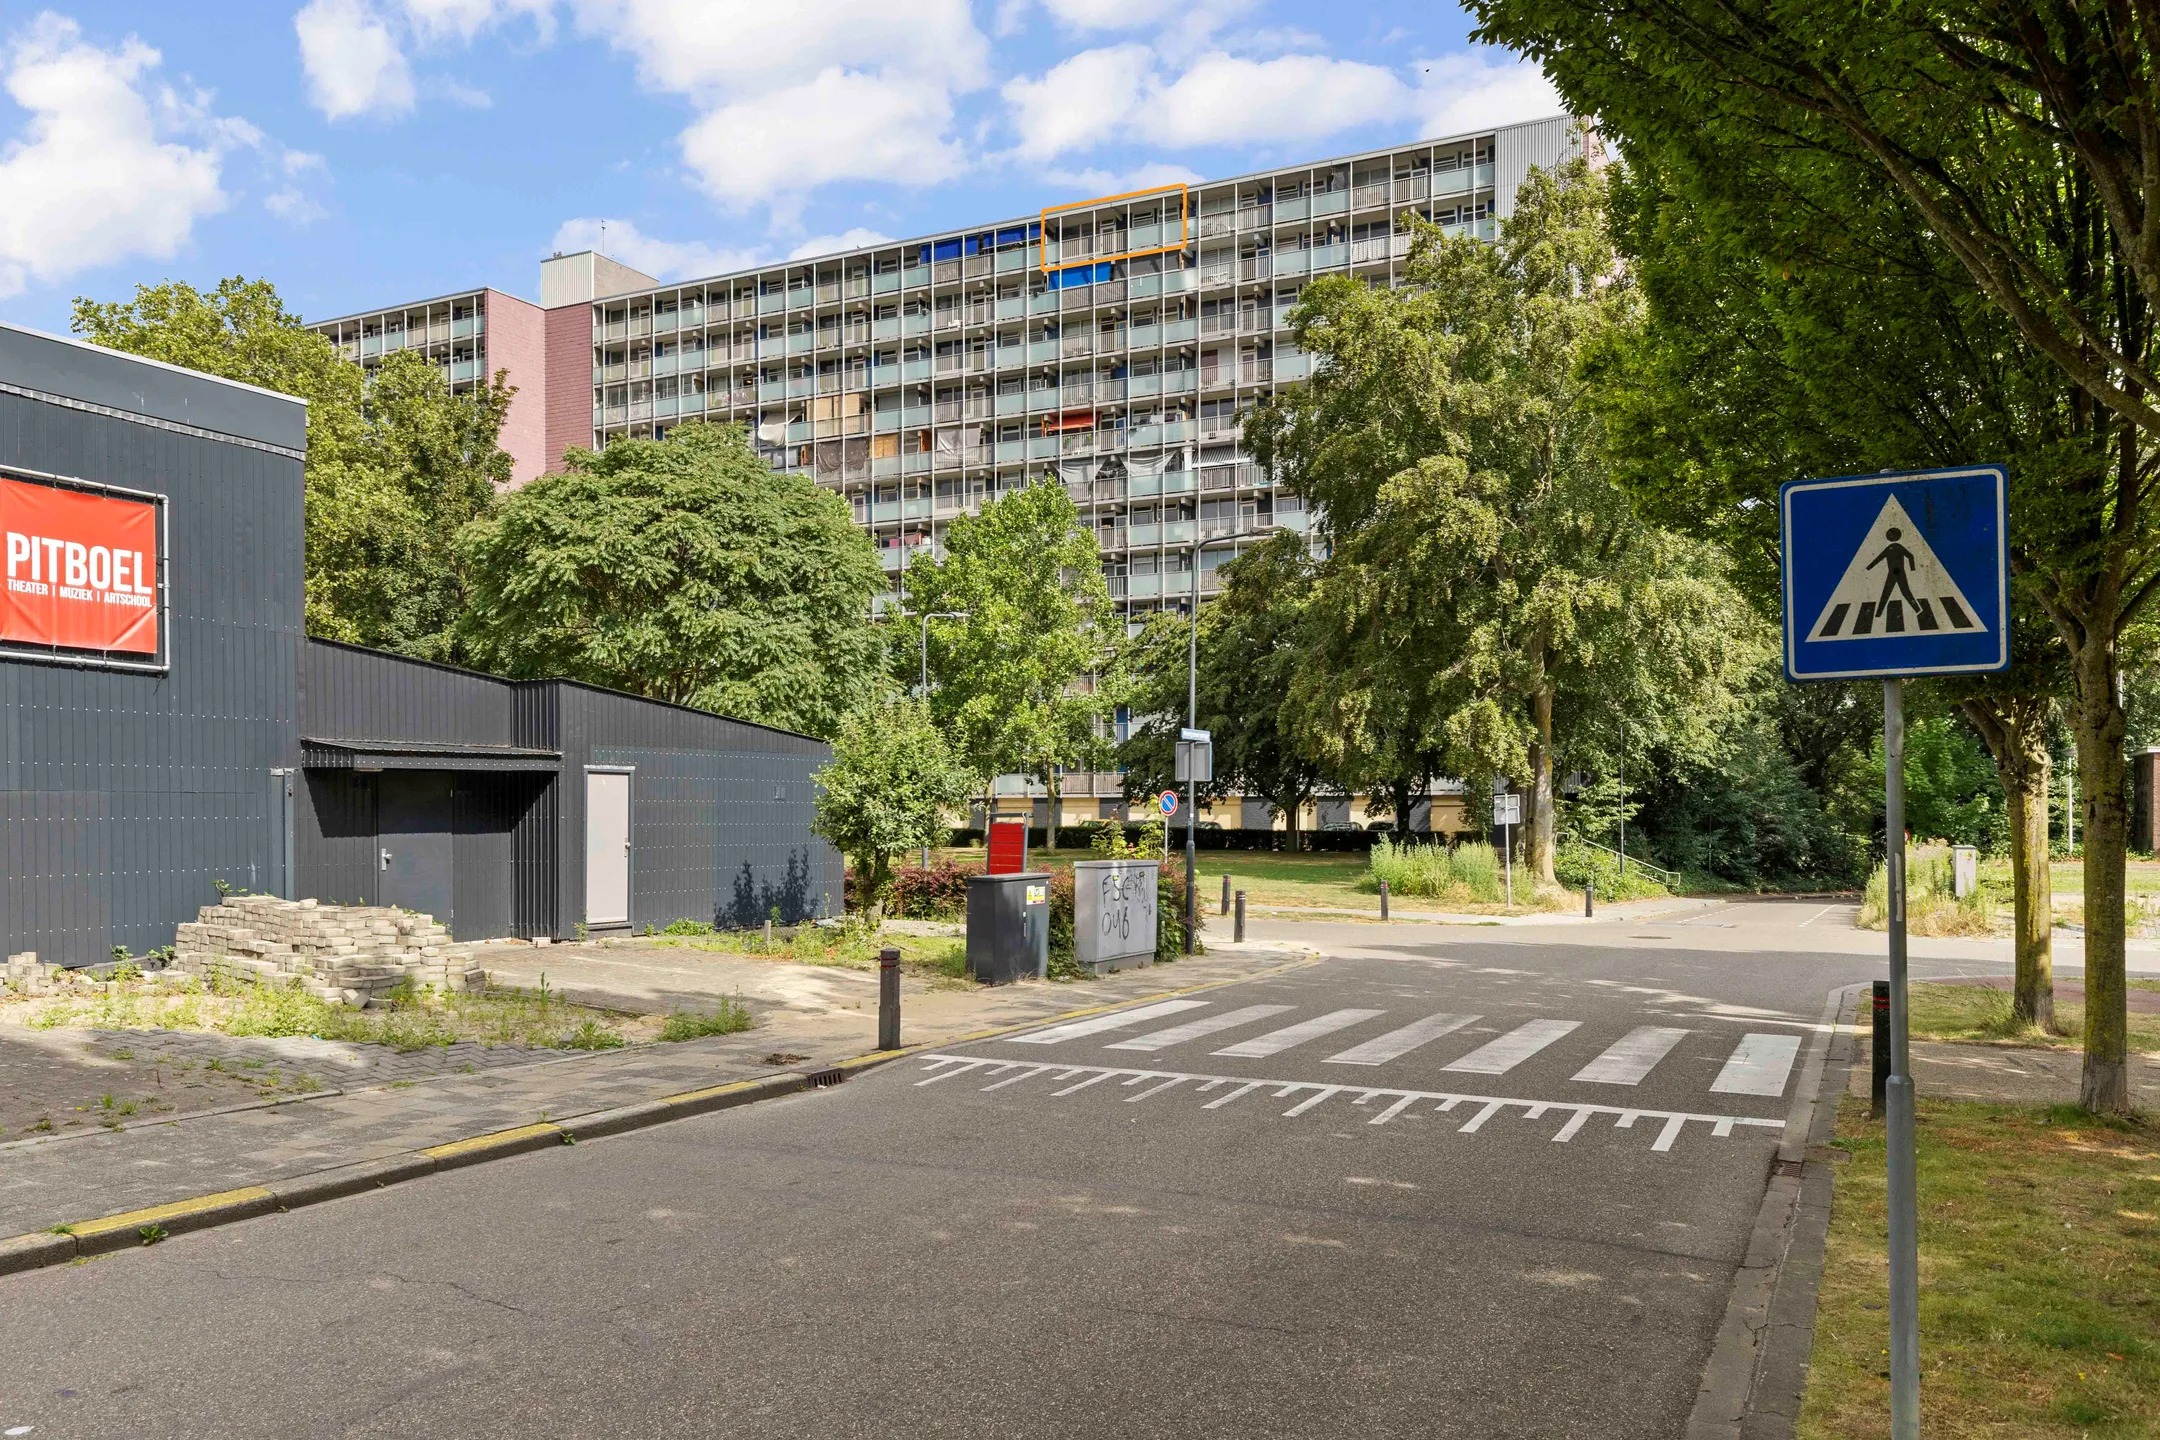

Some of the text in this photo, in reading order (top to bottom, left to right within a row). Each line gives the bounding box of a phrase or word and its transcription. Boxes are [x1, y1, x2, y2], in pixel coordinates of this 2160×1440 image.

[6, 531, 153, 595] PITBOEL
[7, 578, 48, 596] THEATER
[59, 586, 94, 602] MUZIEK
[103, 592, 153, 608] ARTSCHOOL
